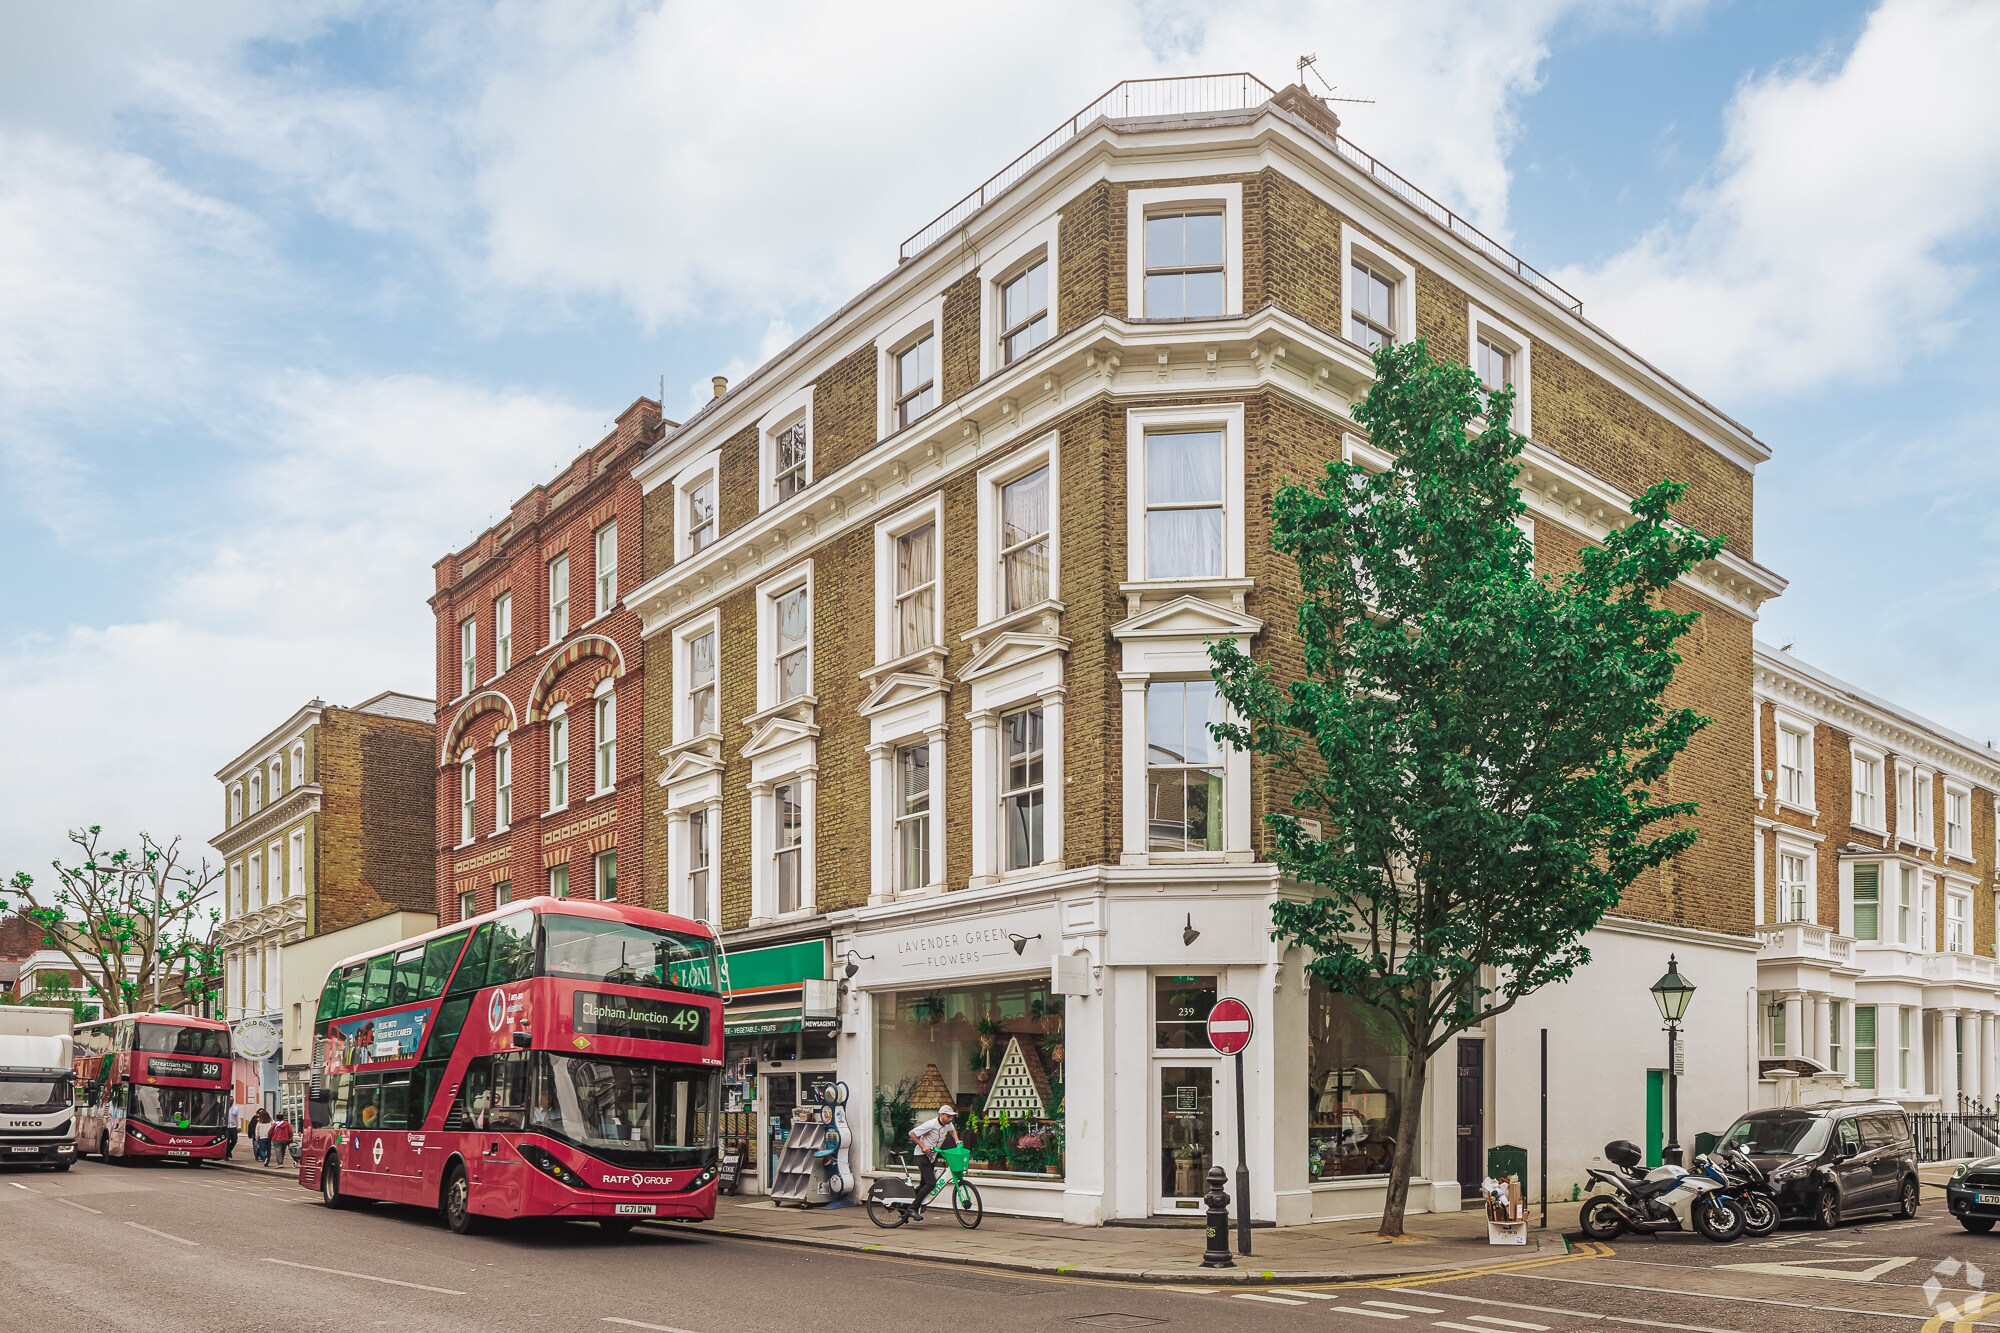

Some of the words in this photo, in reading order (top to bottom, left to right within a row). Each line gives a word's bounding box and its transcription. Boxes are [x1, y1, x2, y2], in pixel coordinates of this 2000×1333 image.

[898, 934, 958, 954] LAVENDER
[966, 928, 1008, 944] GREEN
[927, 951, 980, 967] FLOWERS
[583, 1002, 625, 1020] Clapham
[628, 1008, 668, 1023] Junction
[671, 1009, 700, 1032] 49
[1178, 1008, 1195, 1016] 239
[258, 1020, 276, 1036] DUTCH
[388, 1030, 397, 1038] NEXT
[397, 1027, 412, 1037] CAREER
[734, 1026, 758, 1034] VEGETABLE
[152, 1060, 181, 1068] Streatham
[202, 1063, 219, 1075] 319
[602, 1174, 630, 1184] RATP
[644, 1176, 673, 1184] GROUP
[1980, 1196, 2000, 1204] LG70
